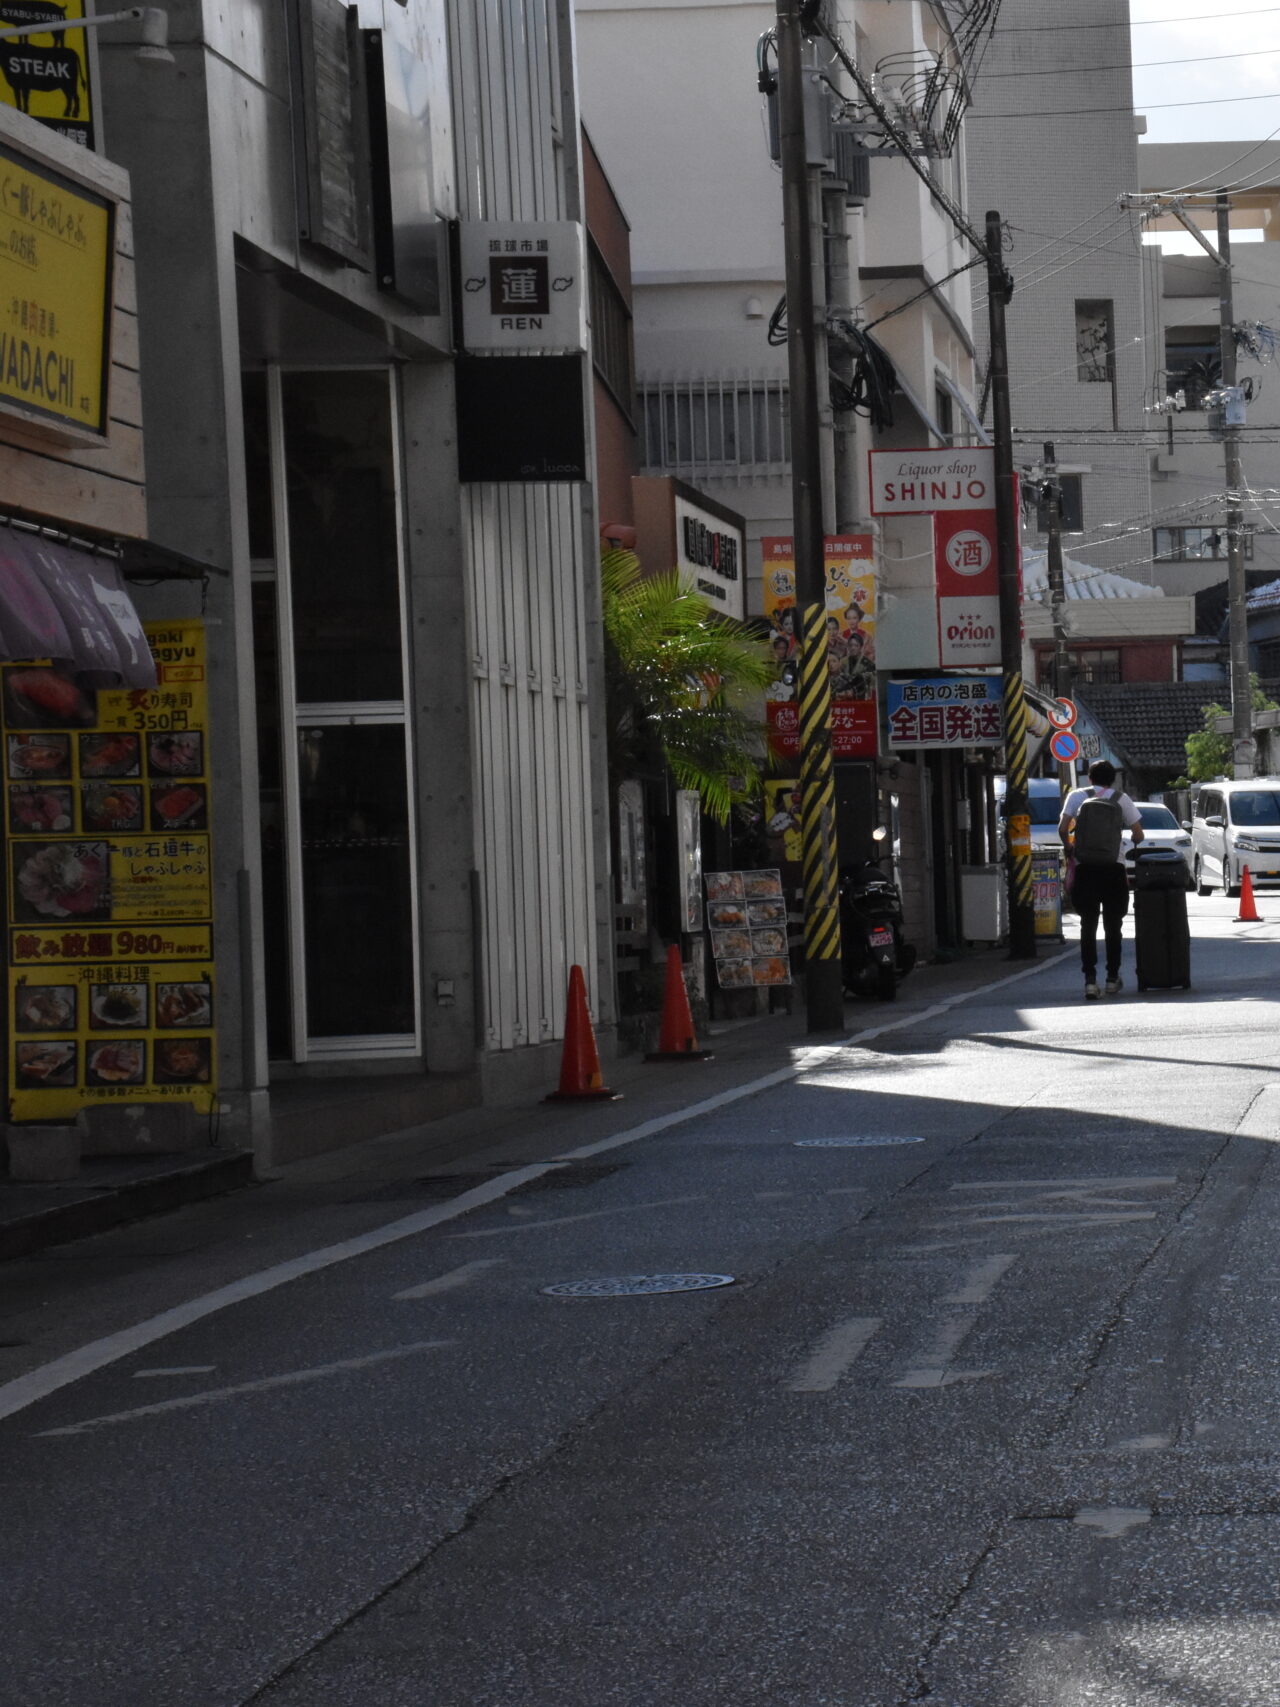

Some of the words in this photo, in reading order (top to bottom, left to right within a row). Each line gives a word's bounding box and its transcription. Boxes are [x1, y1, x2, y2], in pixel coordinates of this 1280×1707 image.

[9, 56, 71, 79] STEAK
[489, 240, 549, 253] 琉球市場
[501, 267, 539, 304] 蓮
[501, 318, 543, 330] REN
[897, 460, 942, 479] Liquor
[946, 459, 977, 479] shop
[885, 479, 987, 502] SHINJO
[954, 539, 983, 568] 酒
[147, 630, 184, 647] gaki
[947, 621, 996, 641] orion
[152, 645, 196, 661] agyu
[902, 683, 988, 702] 店内の泡盛
[134, 710, 188, 730] 350円
[891, 705, 1004, 741] 全国発送
[117, 931, 174, 955] 980円
